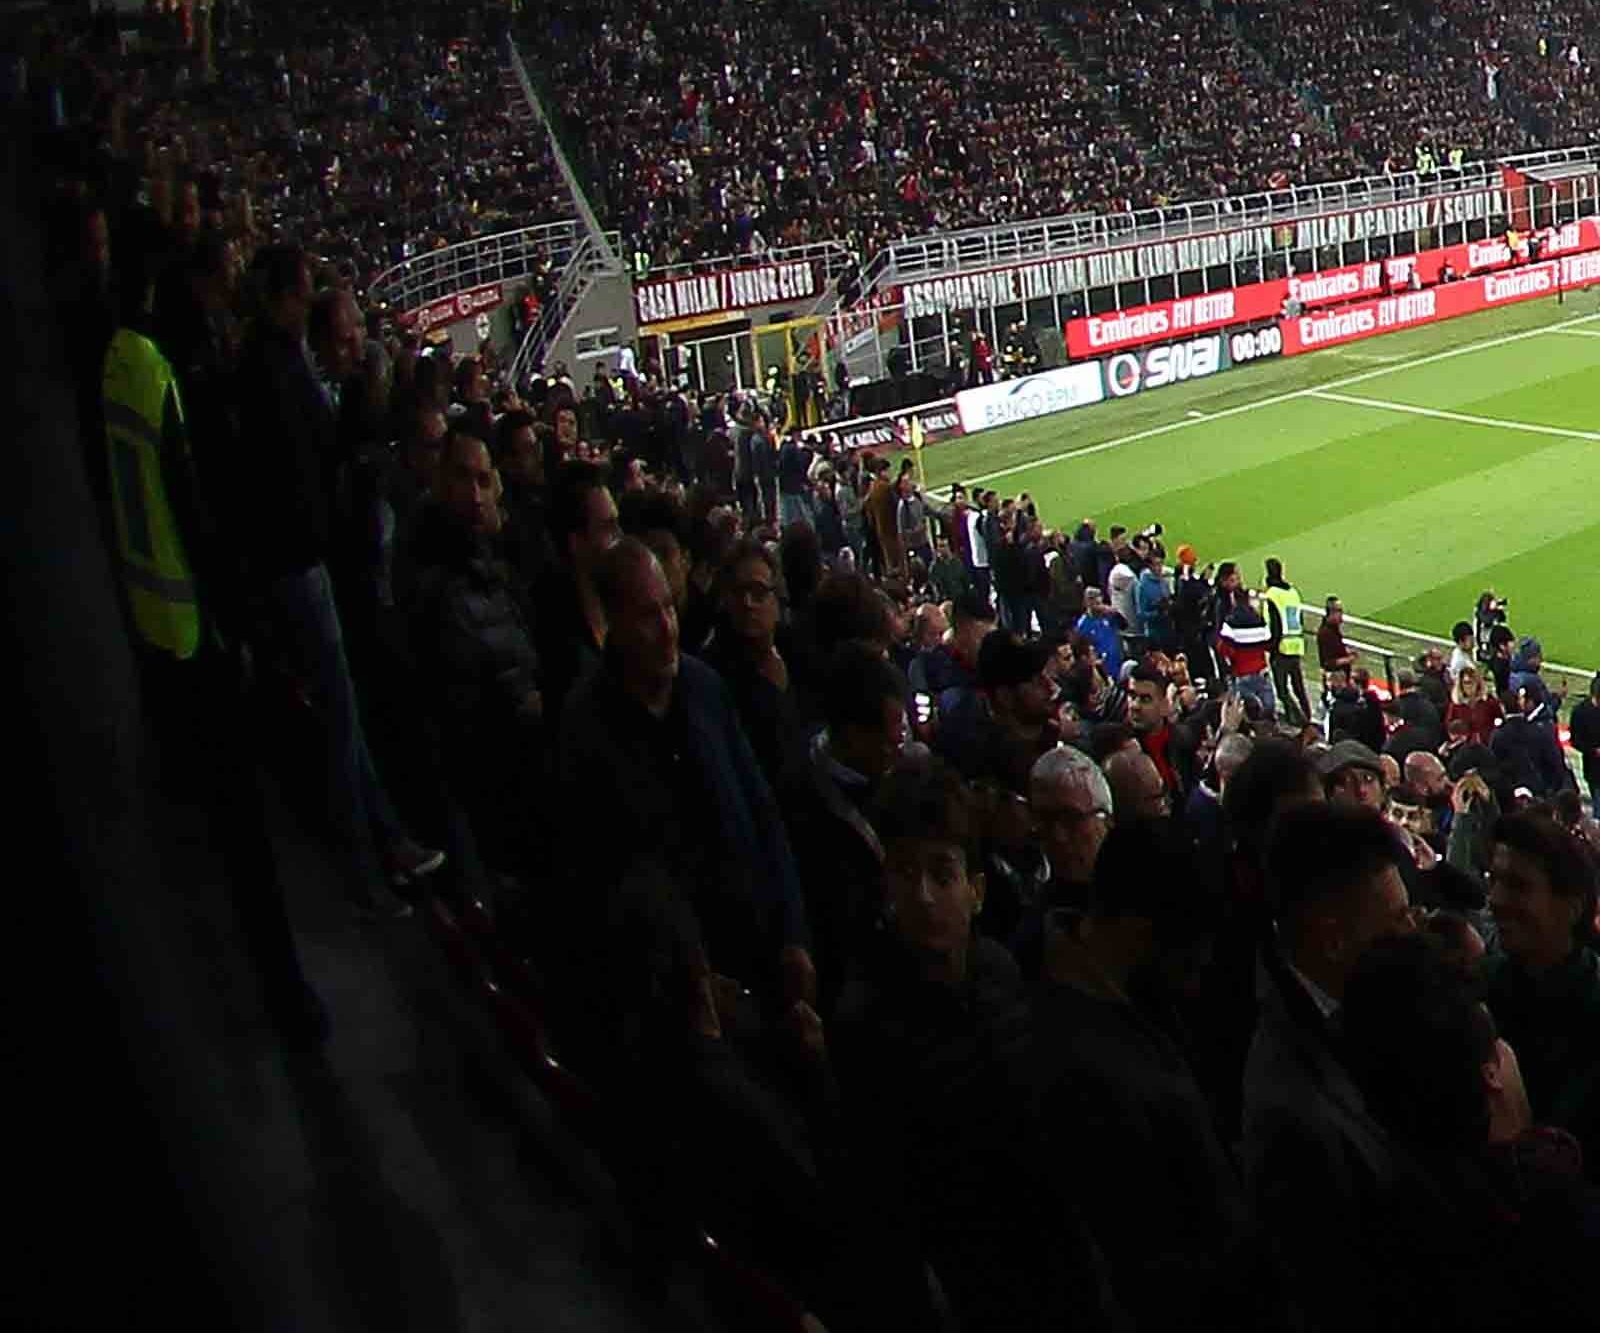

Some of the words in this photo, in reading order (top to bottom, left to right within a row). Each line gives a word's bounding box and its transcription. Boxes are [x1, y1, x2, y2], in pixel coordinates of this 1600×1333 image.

[1296, 214, 1349, 253] MILAN
[1351, 200, 1428, 246] ACADEMY
[1443, 190, 1502, 225] SCUOLA
[639, 284, 676, 323] CASA
[676, 277, 719, 316] MILAN
[730, 267, 779, 308] JUNIOR
[780, 261, 815, 301] CLUB
[903, 270, 1016, 318] ASSOCIAZIONE
[1022, 258, 1085, 299] ITALIANA
[1087, 246, 1134, 292] MILAN
[1137, 240, 1176, 278] CLUB
[1289, 271, 1359, 302] Emirates
[1088, 309, 1170, 347] Emirates
[1173, 301, 1194, 330] FLY
[1231, 325, 1281, 363] 00:00
[1299, 312, 1376, 345] Emirates
[1379, 298, 1397, 326] FLY
[985, 394, 1041, 426] BANCO
